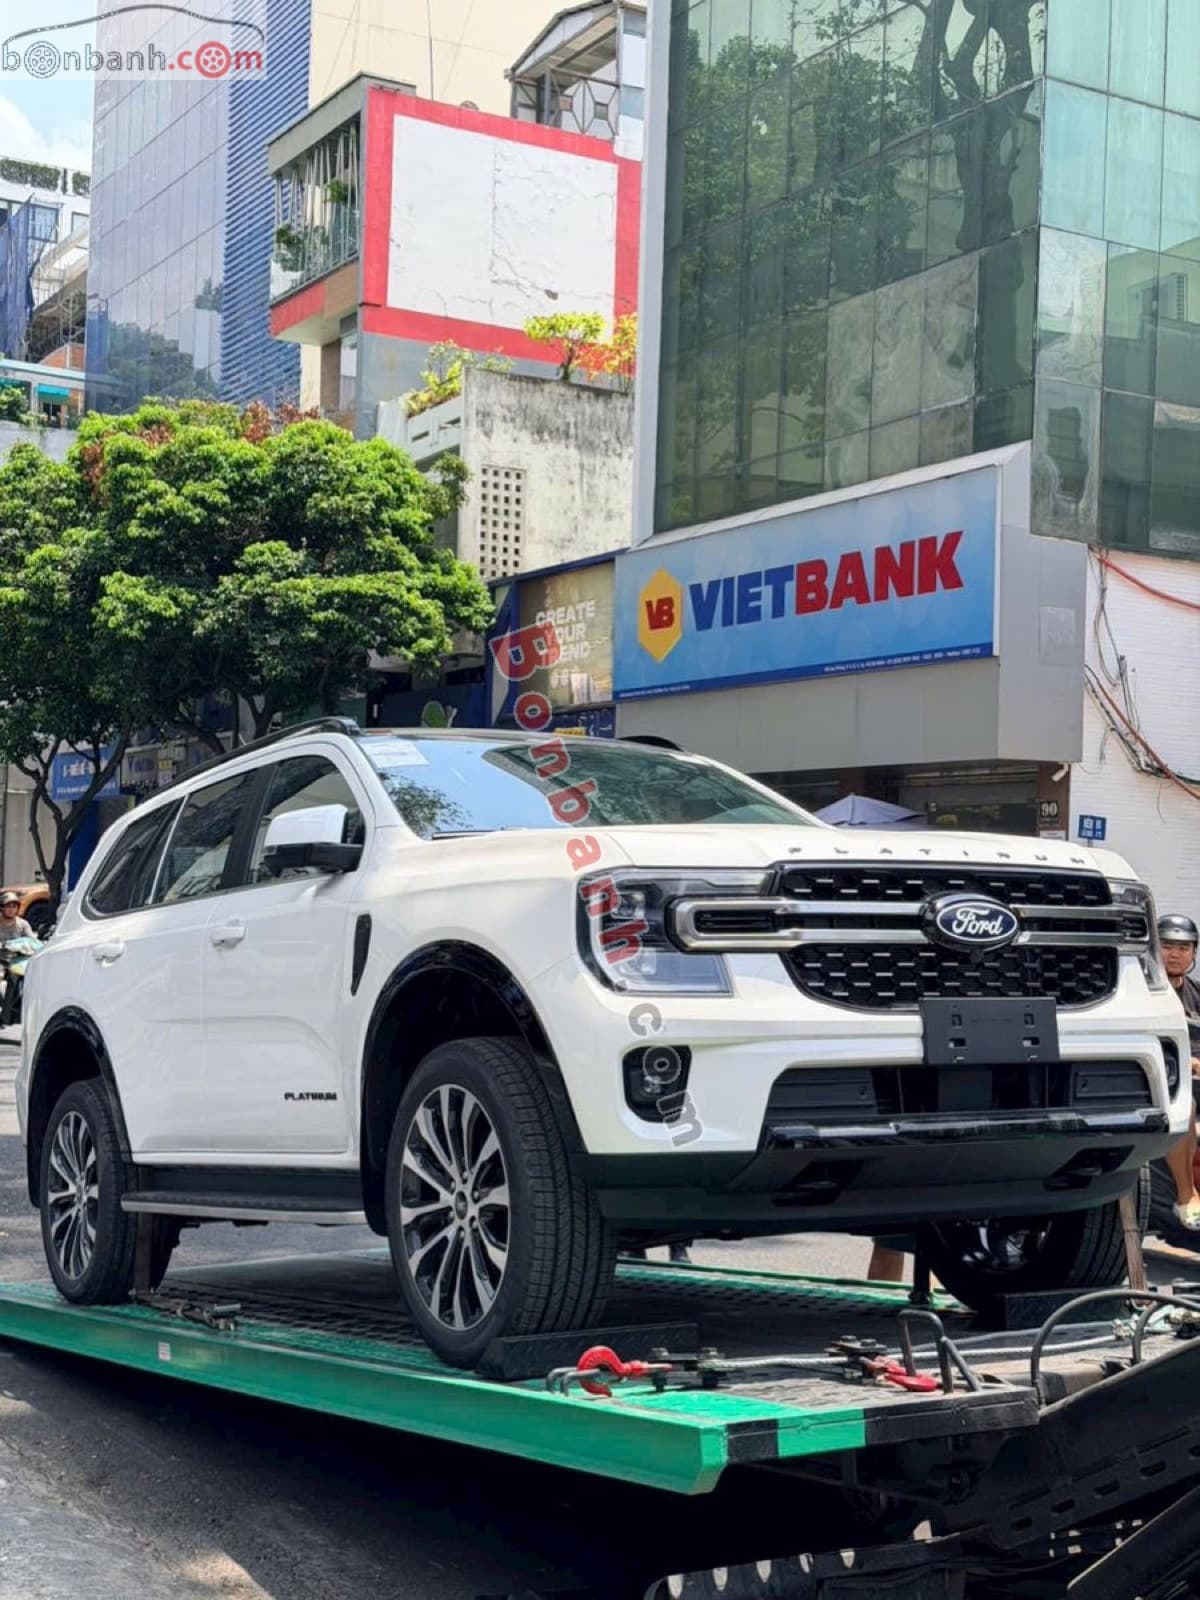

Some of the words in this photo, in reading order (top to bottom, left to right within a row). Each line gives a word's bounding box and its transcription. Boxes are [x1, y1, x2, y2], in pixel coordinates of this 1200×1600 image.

[689, 531, 964, 632] VIETBANK
[535, 600, 596, 627] CREATE
[646, 597, 675, 631] VB
[1041, 802, 1058, 817] 90
[951, 907, 1003, 935] Ford
